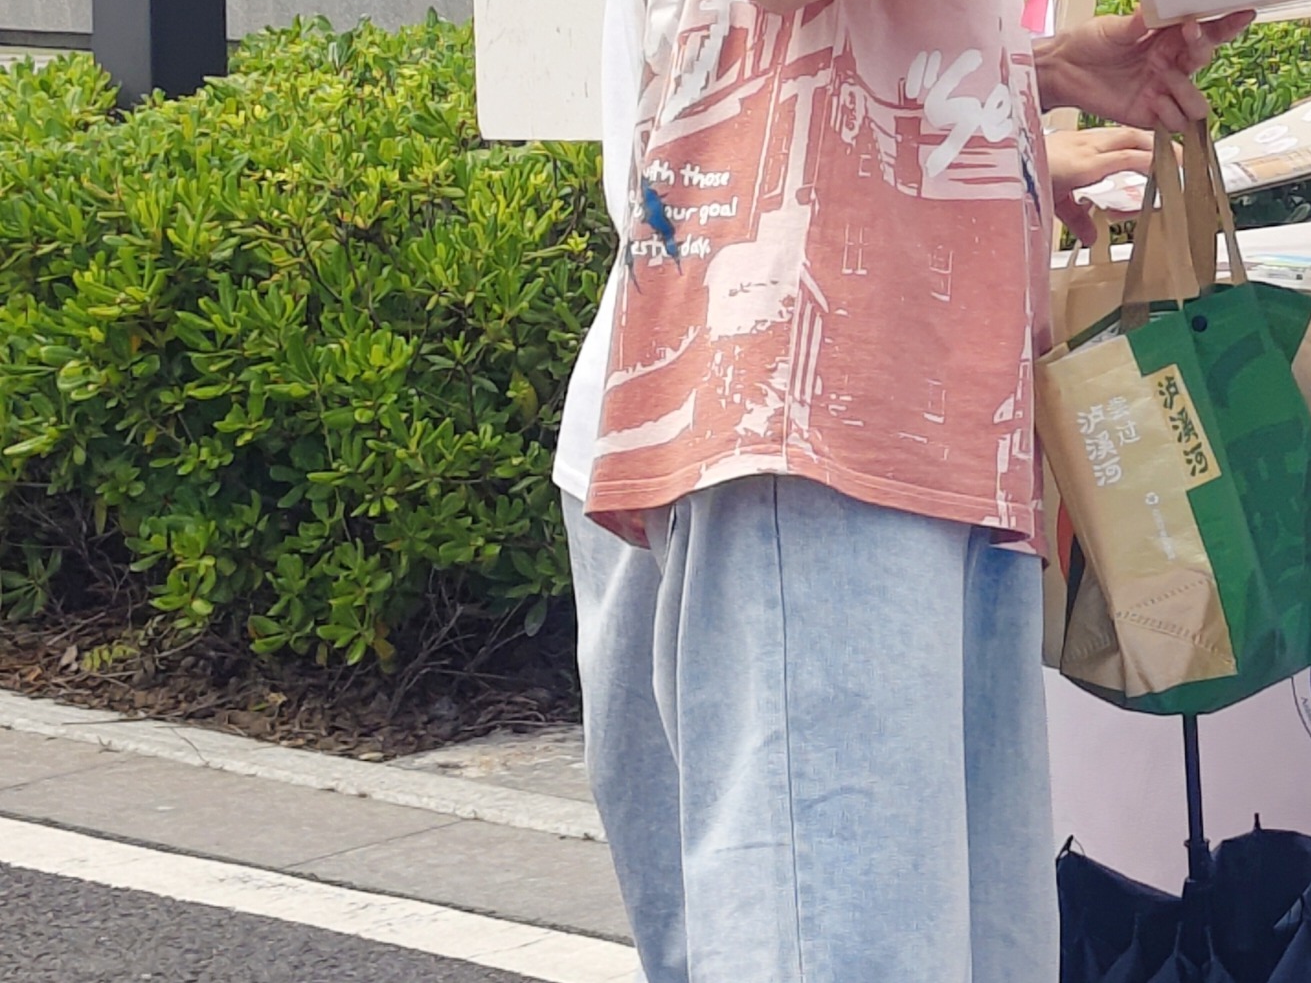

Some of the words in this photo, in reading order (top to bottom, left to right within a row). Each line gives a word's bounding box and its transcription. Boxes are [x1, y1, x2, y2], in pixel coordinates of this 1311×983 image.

[680, 162, 731, 189] those
[699, 196, 738, 225] goal
[1077, 404, 1122, 487] 泸溪河
[1157, 375, 1209, 477] 泸溪河
